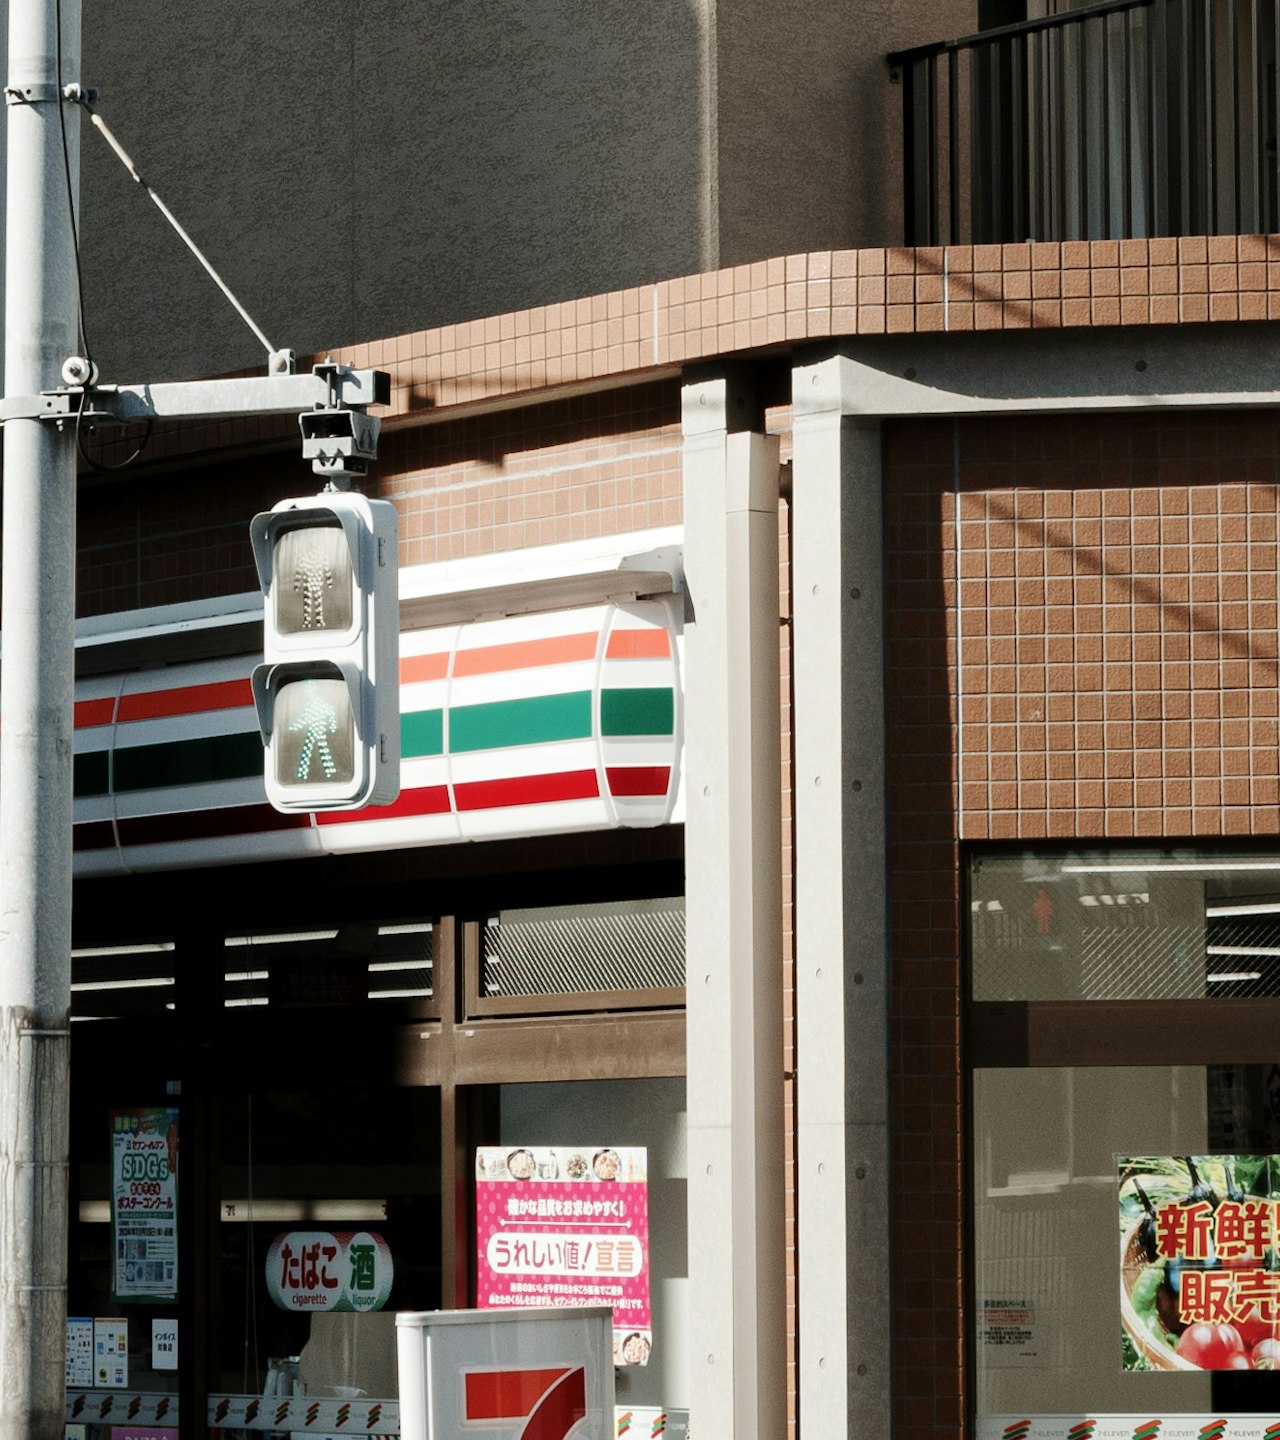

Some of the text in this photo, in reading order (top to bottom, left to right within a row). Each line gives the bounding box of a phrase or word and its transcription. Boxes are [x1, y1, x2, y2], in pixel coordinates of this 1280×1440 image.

[121, 1153, 169, 1181] SDGs
[281, 1241, 376, 1291] たばこ 酒
[494, 1238, 635, 1274] うれしい値!宣言
[292, 1293, 376, 1308] cigarette liquor
